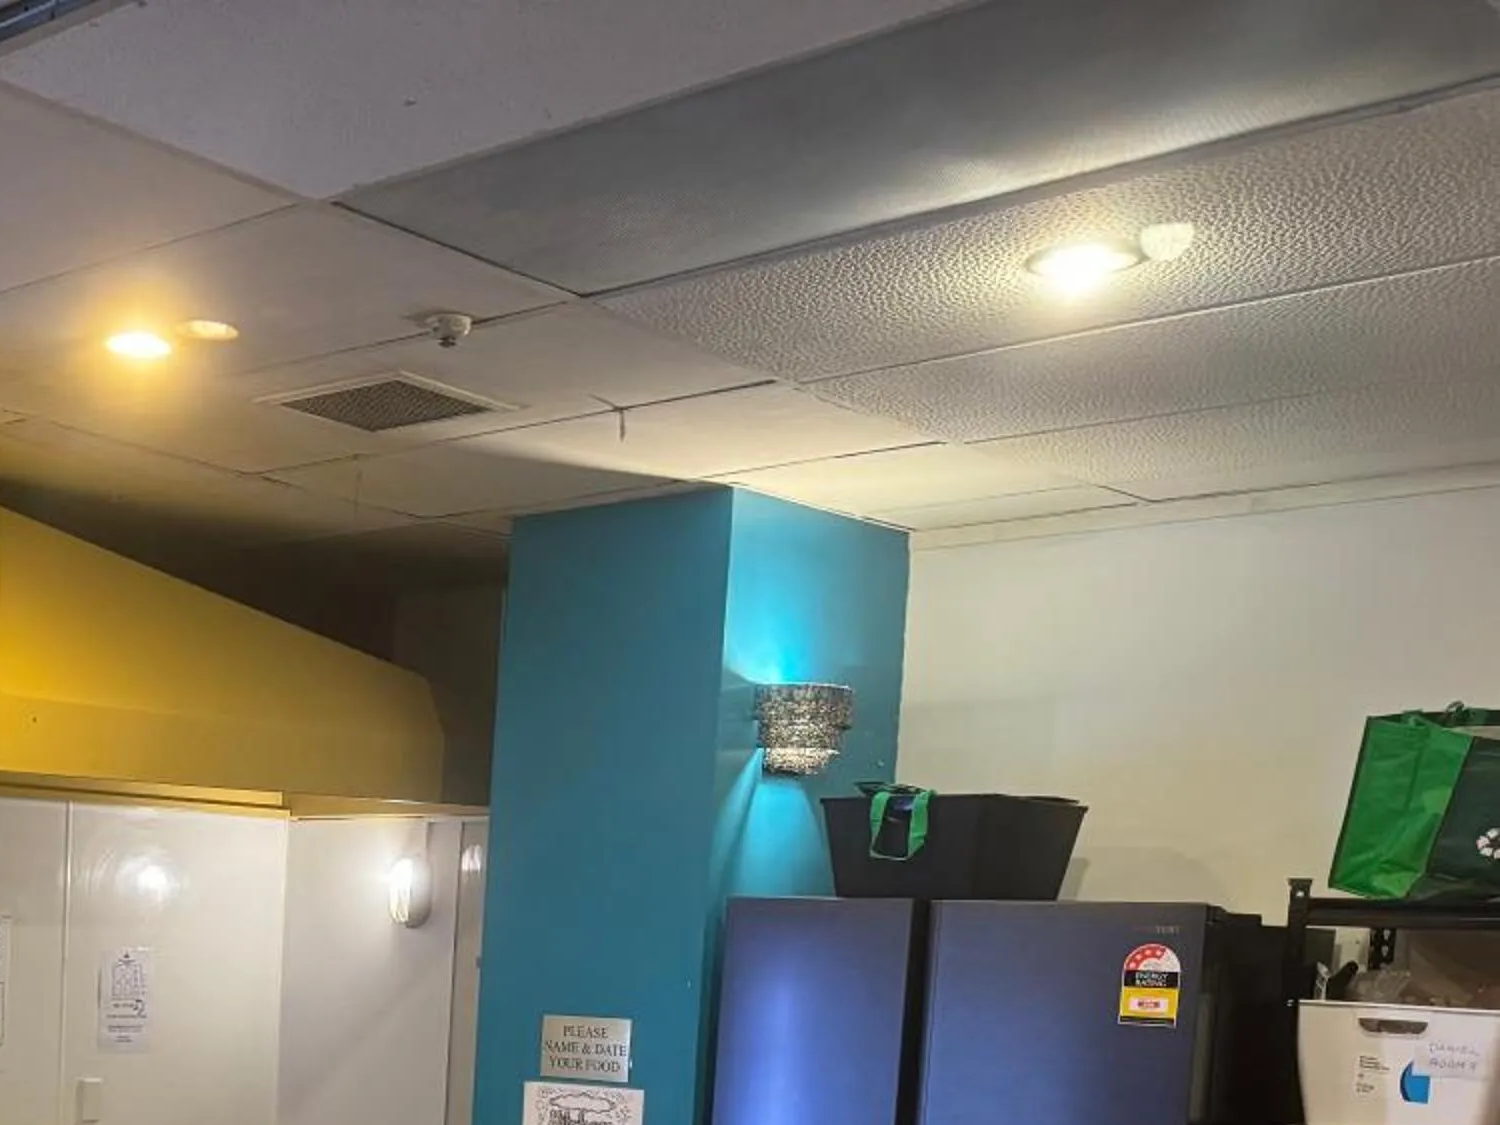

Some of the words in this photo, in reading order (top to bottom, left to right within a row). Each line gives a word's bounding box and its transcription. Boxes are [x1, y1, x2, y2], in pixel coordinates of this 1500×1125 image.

[562, 1024, 609, 1039] PLEASE
[544, 1040, 580, 1054] NAME
[581, 1043, 592, 1055] &
[594, 1043, 628, 1057] DATE
[548, 1056, 583, 1071] YOUR
[585, 1059, 621, 1073] FOOD
